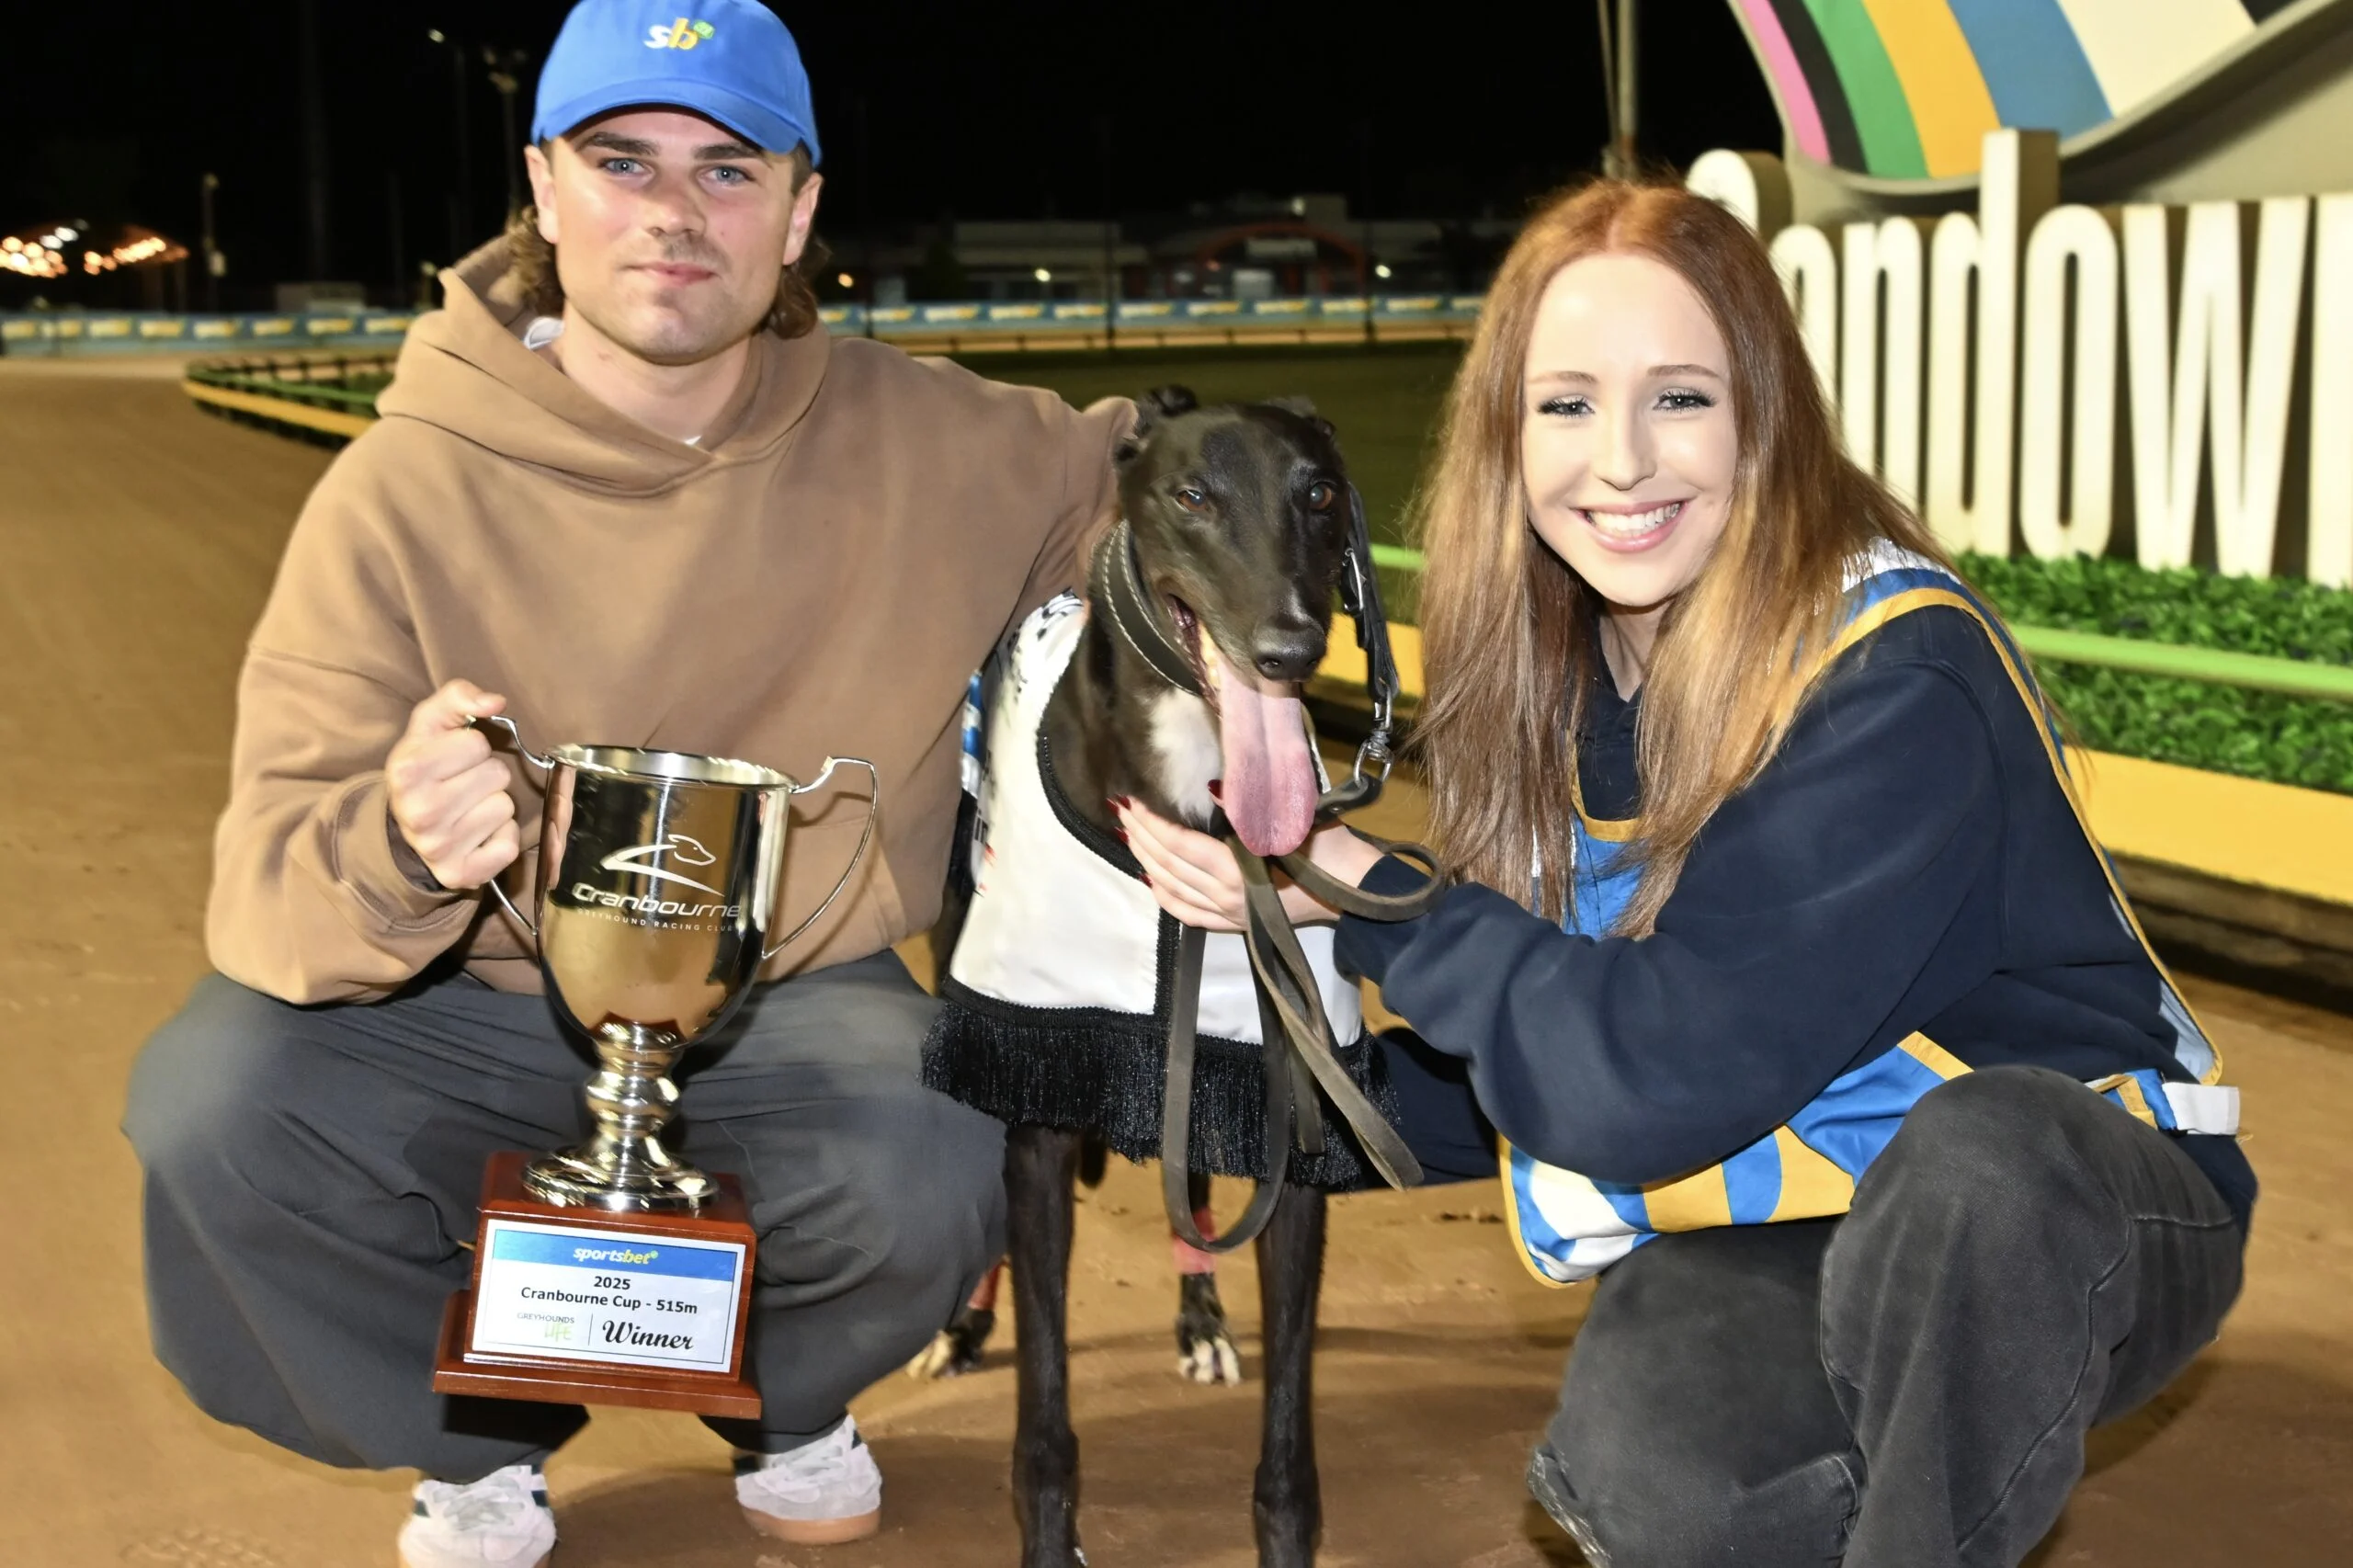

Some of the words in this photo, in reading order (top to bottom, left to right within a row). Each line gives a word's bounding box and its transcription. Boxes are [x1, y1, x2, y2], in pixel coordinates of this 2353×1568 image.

[644, 17, 699, 50] sb
[577, 908, 647, 926] GREYHOUND
[654, 920, 700, 931] RACING
[573, 1247, 653, 1265] sportsbet
[593, 1276, 631, 1290] 2025
[520, 1287, 608, 1306] Cranbourne
[612, 1295, 642, 1312] Cup
[655, 1299, 699, 1314] 515m
[517, 1312, 575, 1324] GREYHOUNDS
[602, 1320, 695, 1351] Winner
